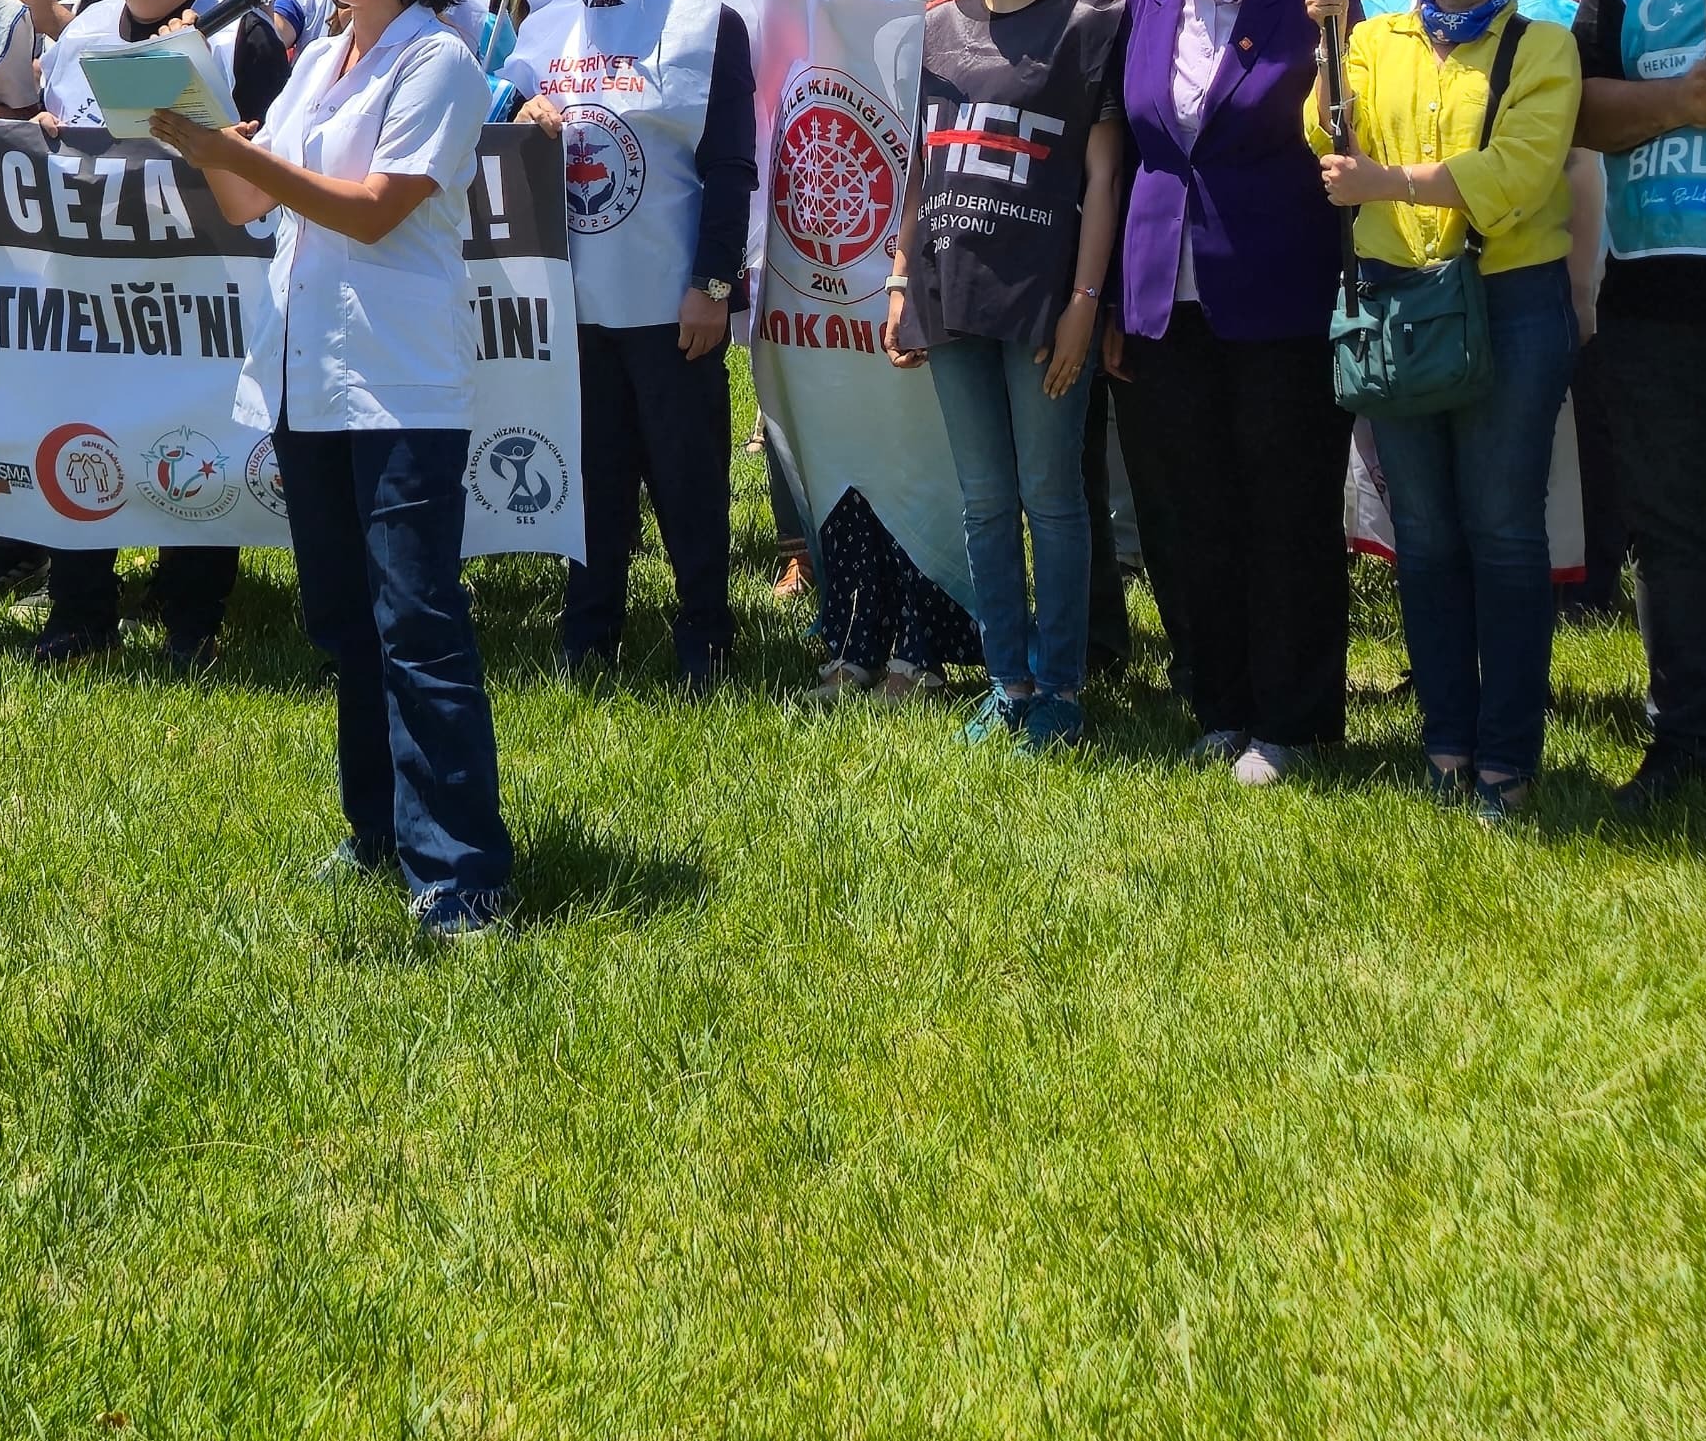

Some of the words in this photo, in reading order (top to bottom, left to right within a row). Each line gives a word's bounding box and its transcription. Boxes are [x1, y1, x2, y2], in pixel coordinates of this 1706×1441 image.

[549, 52, 639, 74] HÜRRİYET
[1643, 54, 1687, 73] HEKİM
[539, 76, 597, 96] SAĞLIK
[601, 75, 646, 93] SEN
[70, 96, 95, 124] NKA
[619, 135, 639, 162] SEN
[2, 150, 194, 241] CEZA
[955, 194, 1053, 227] DERNEKLERİ
[810, 273, 848, 295] 2011
[471, 284, 551, 362] İN!
[493, 426, 526, 440] HİZMET
[248, 437, 273, 477] HÜRRİY
[471, 437, 494, 468] SOSYAL
[470, 482, 493, 511] SAĞLIK
[516, 516, 536, 525] SES
